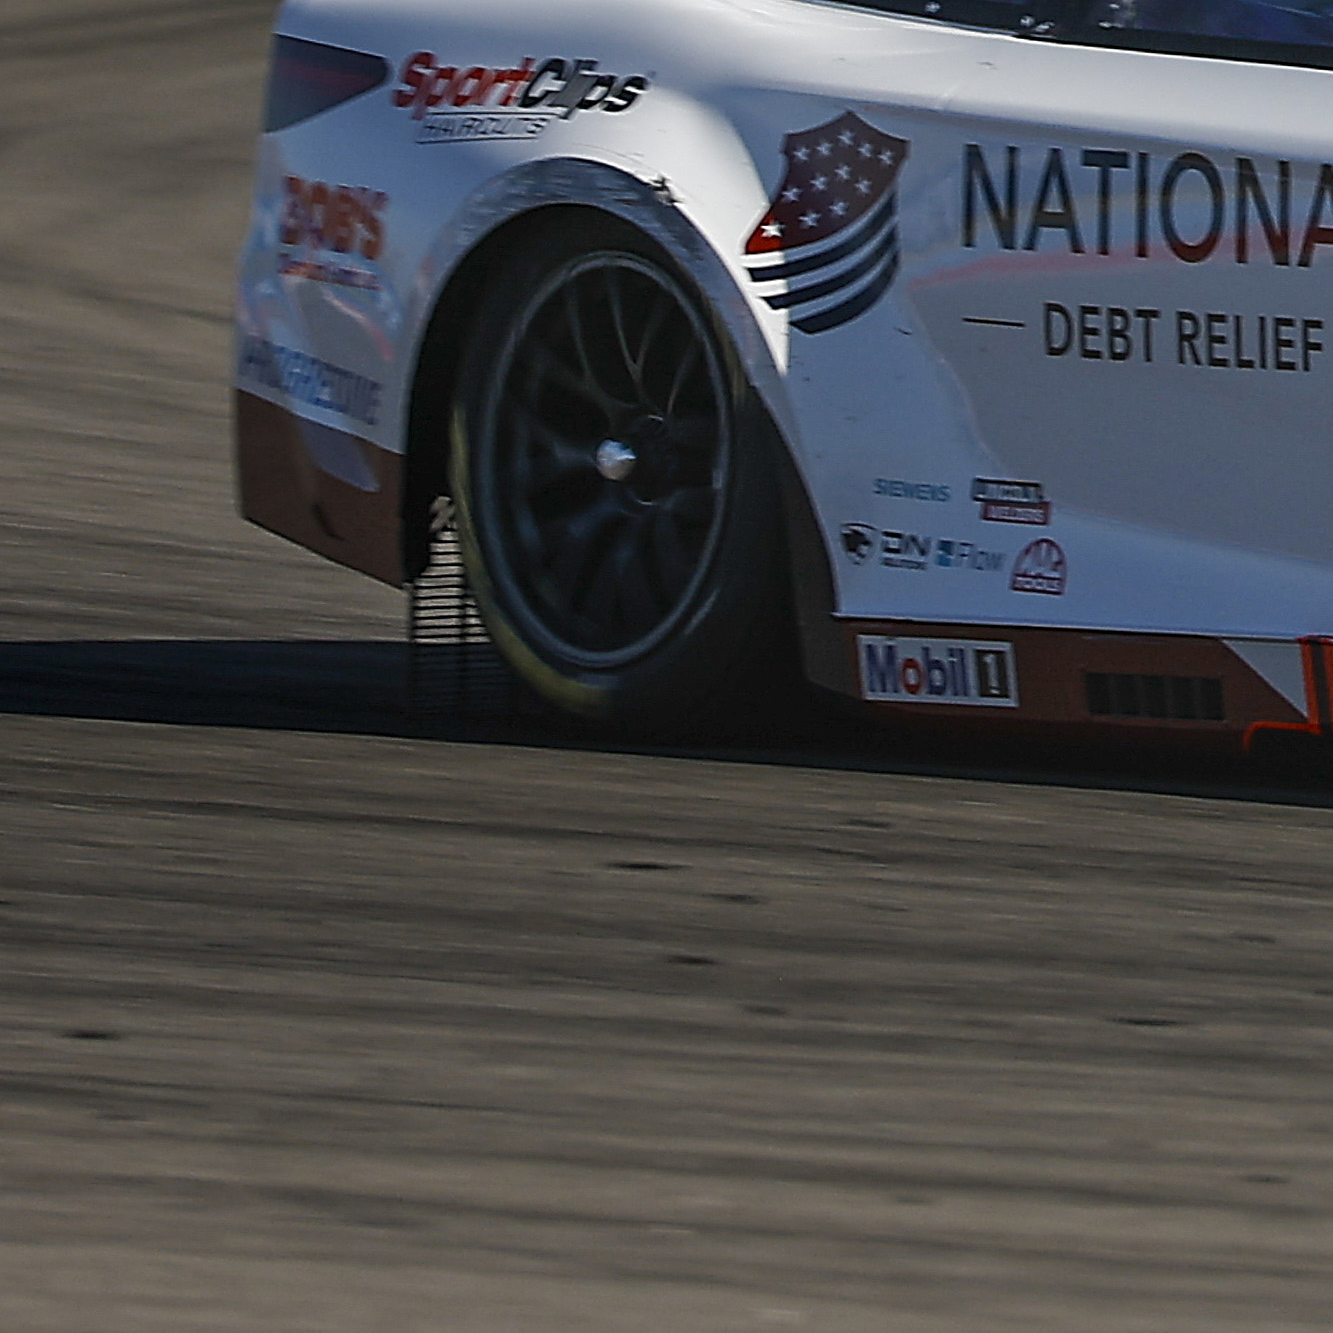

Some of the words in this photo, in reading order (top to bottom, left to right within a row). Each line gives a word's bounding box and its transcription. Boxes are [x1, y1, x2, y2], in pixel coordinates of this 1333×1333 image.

[1043, 303, 1160, 363] DEBT
[1176, 310, 1324, 372] RELIEF
[865, 643, 970, 697] Mobil
[981, 651, 1002, 697] 1
